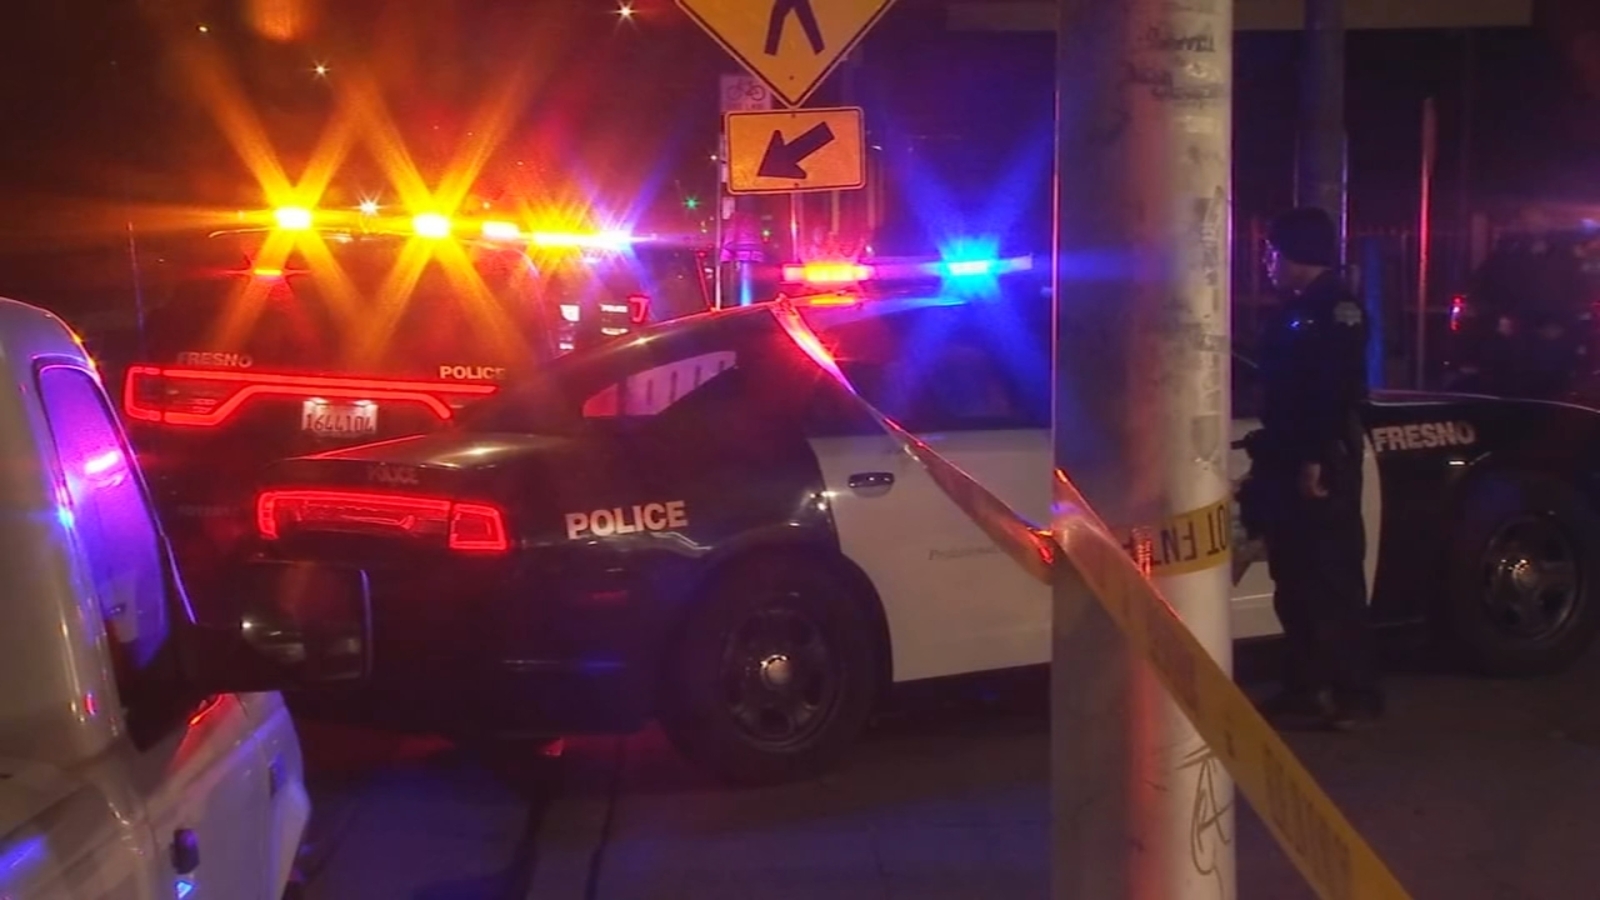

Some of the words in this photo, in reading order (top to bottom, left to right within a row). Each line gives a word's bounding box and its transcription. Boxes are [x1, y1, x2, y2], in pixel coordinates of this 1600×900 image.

[177, 351, 253, 369] FRESNO
[439, 365, 505, 380] POLICE
[1371, 420, 1476, 453] FRESNO
[565, 500, 688, 540] POLICE
